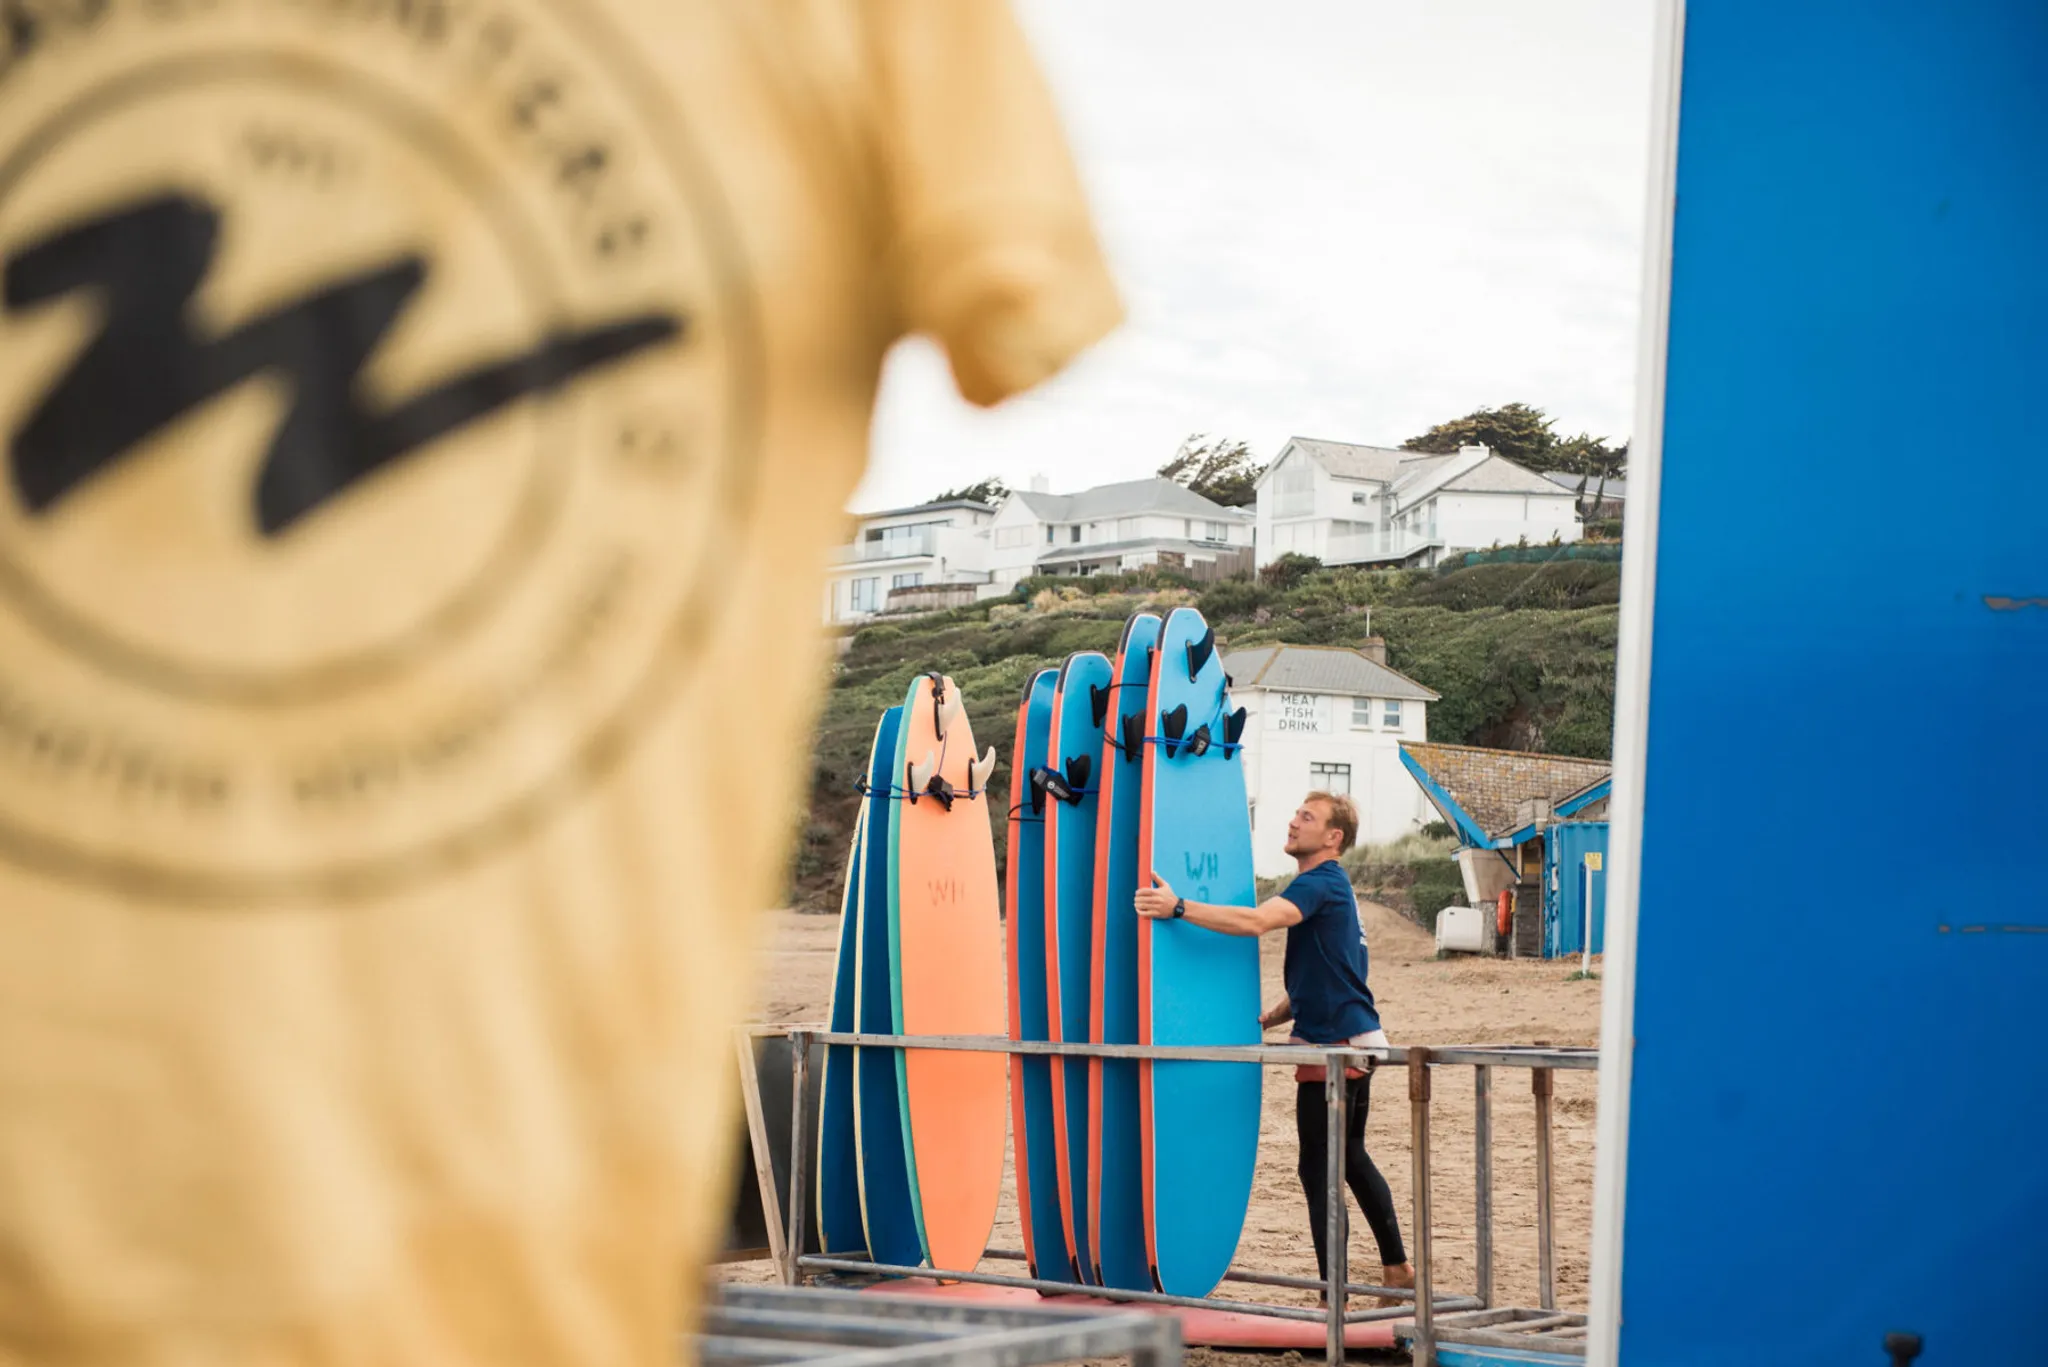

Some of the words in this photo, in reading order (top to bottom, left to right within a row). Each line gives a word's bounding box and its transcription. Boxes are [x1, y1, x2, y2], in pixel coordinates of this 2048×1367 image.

[1280, 693, 1318, 706] MEAT
[1284, 706, 1314, 718] FISH
[1278, 719, 1319, 732] DRINK
[1184, 851, 1218, 880] WH
